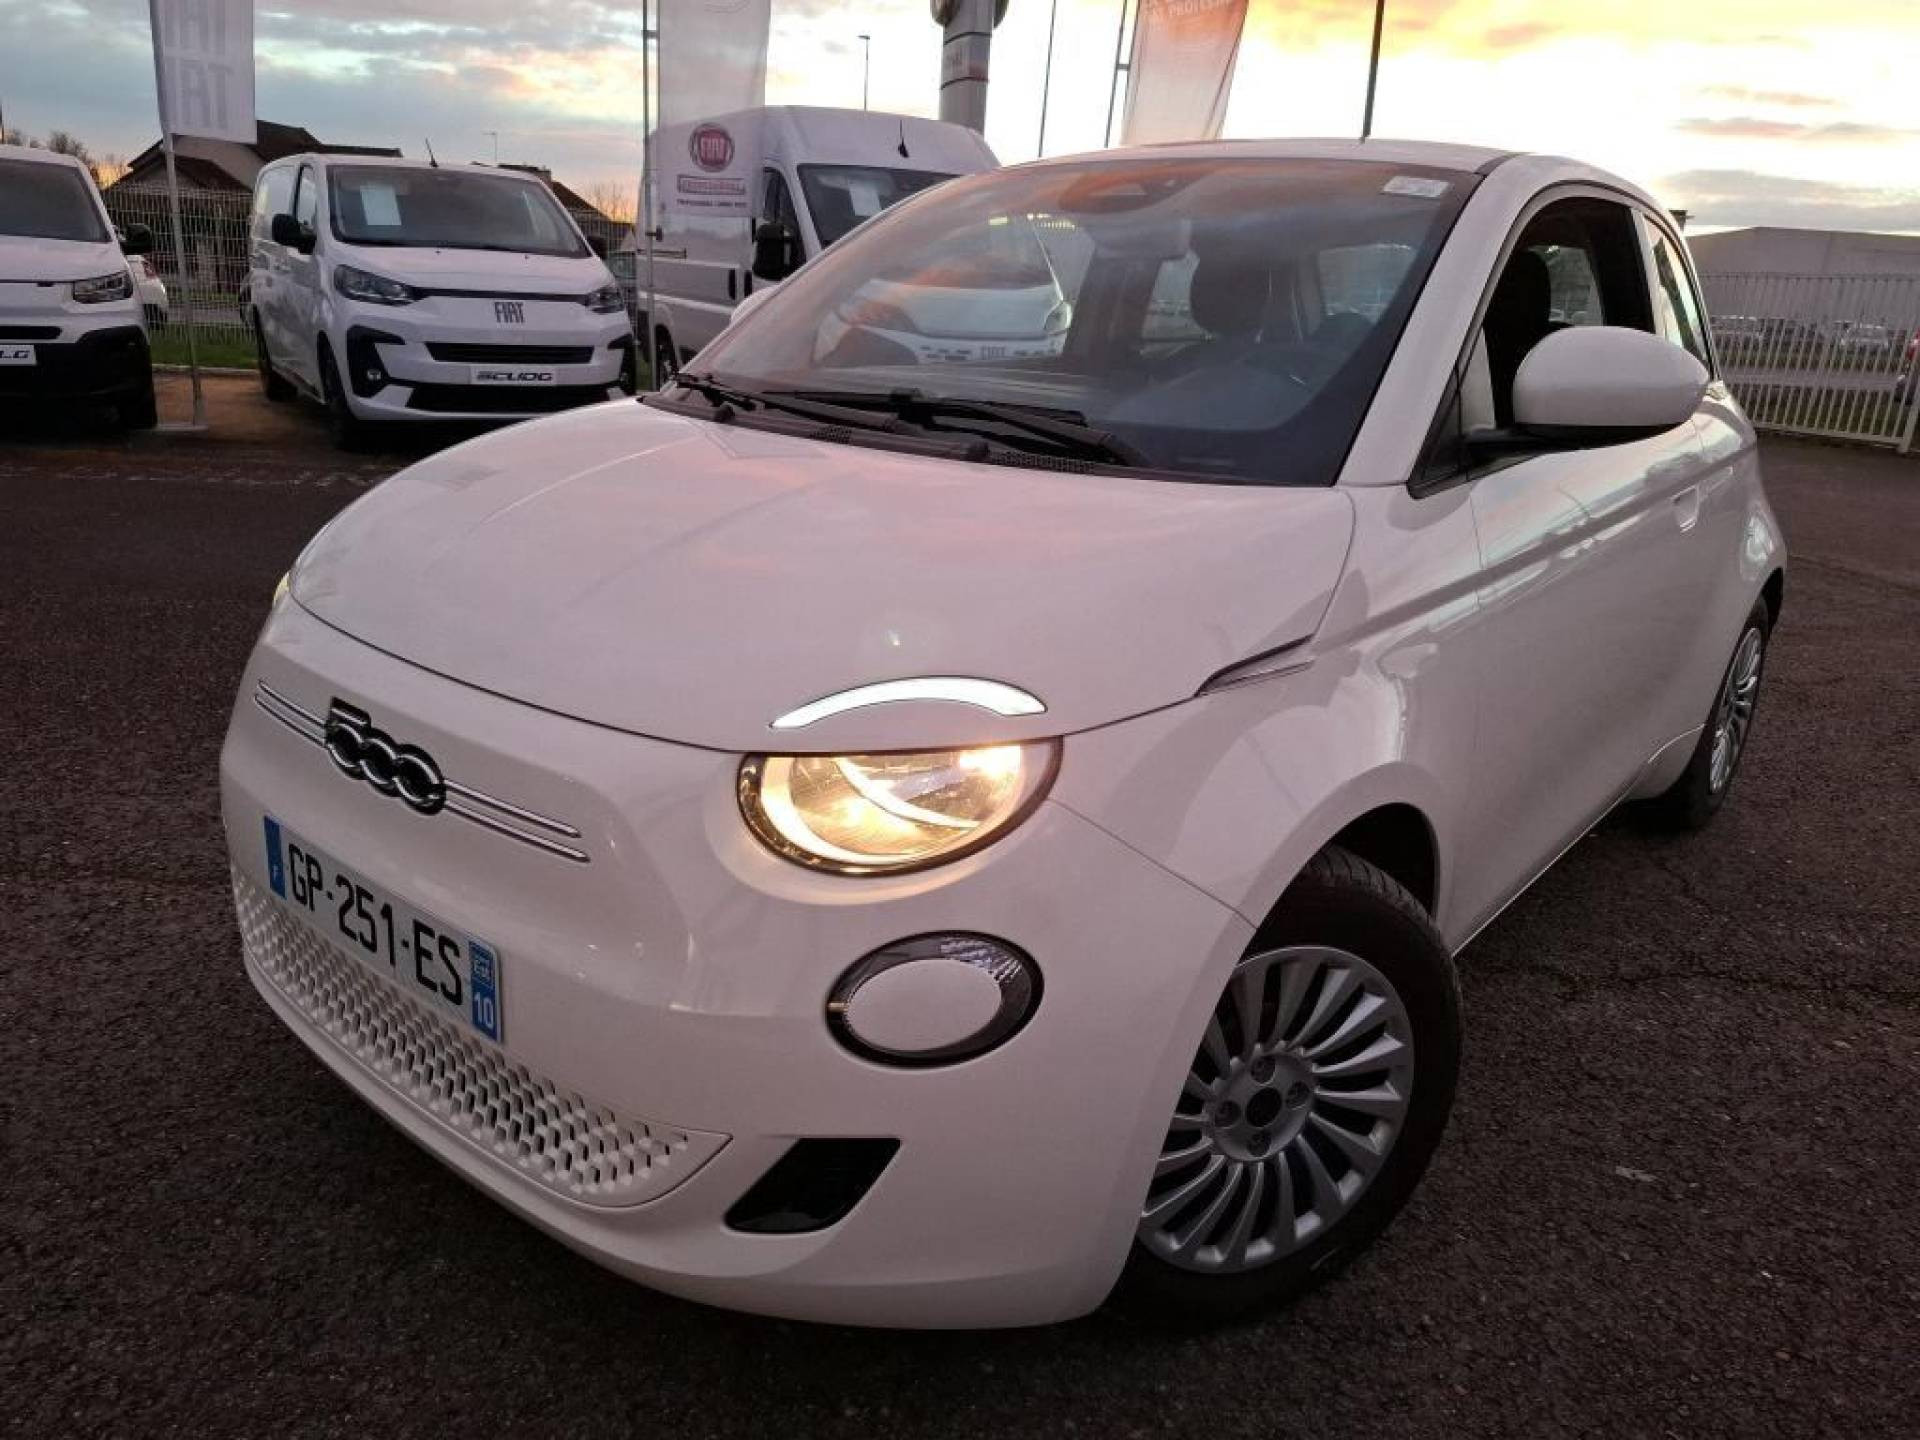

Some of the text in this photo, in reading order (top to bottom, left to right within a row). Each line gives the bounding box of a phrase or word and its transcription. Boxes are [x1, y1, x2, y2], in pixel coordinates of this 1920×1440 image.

[494, 301, 525, 324] FIAT
[325, 697, 447, 816] 500
[288, 843, 463, 1005] GP-251-ES
[474, 991, 494, 1030] 10
